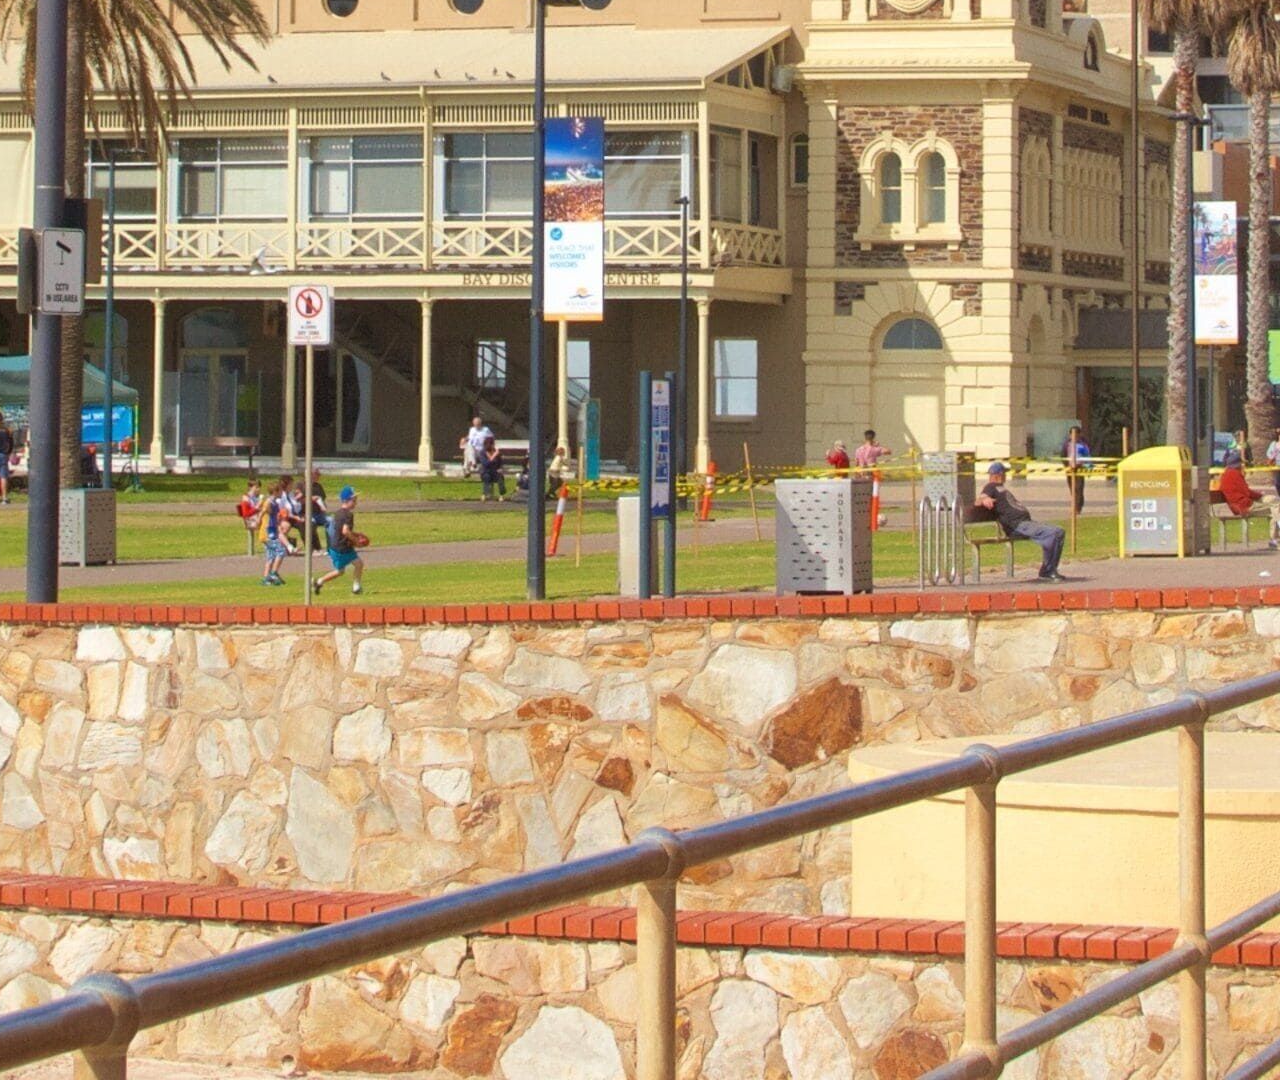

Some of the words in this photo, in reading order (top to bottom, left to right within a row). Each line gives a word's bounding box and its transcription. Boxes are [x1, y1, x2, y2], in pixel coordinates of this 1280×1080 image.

[463, 273, 493, 286] BAY
[607, 273, 661, 286] ENTRE
[1130, 481, 1171, 489] RECYCLING
